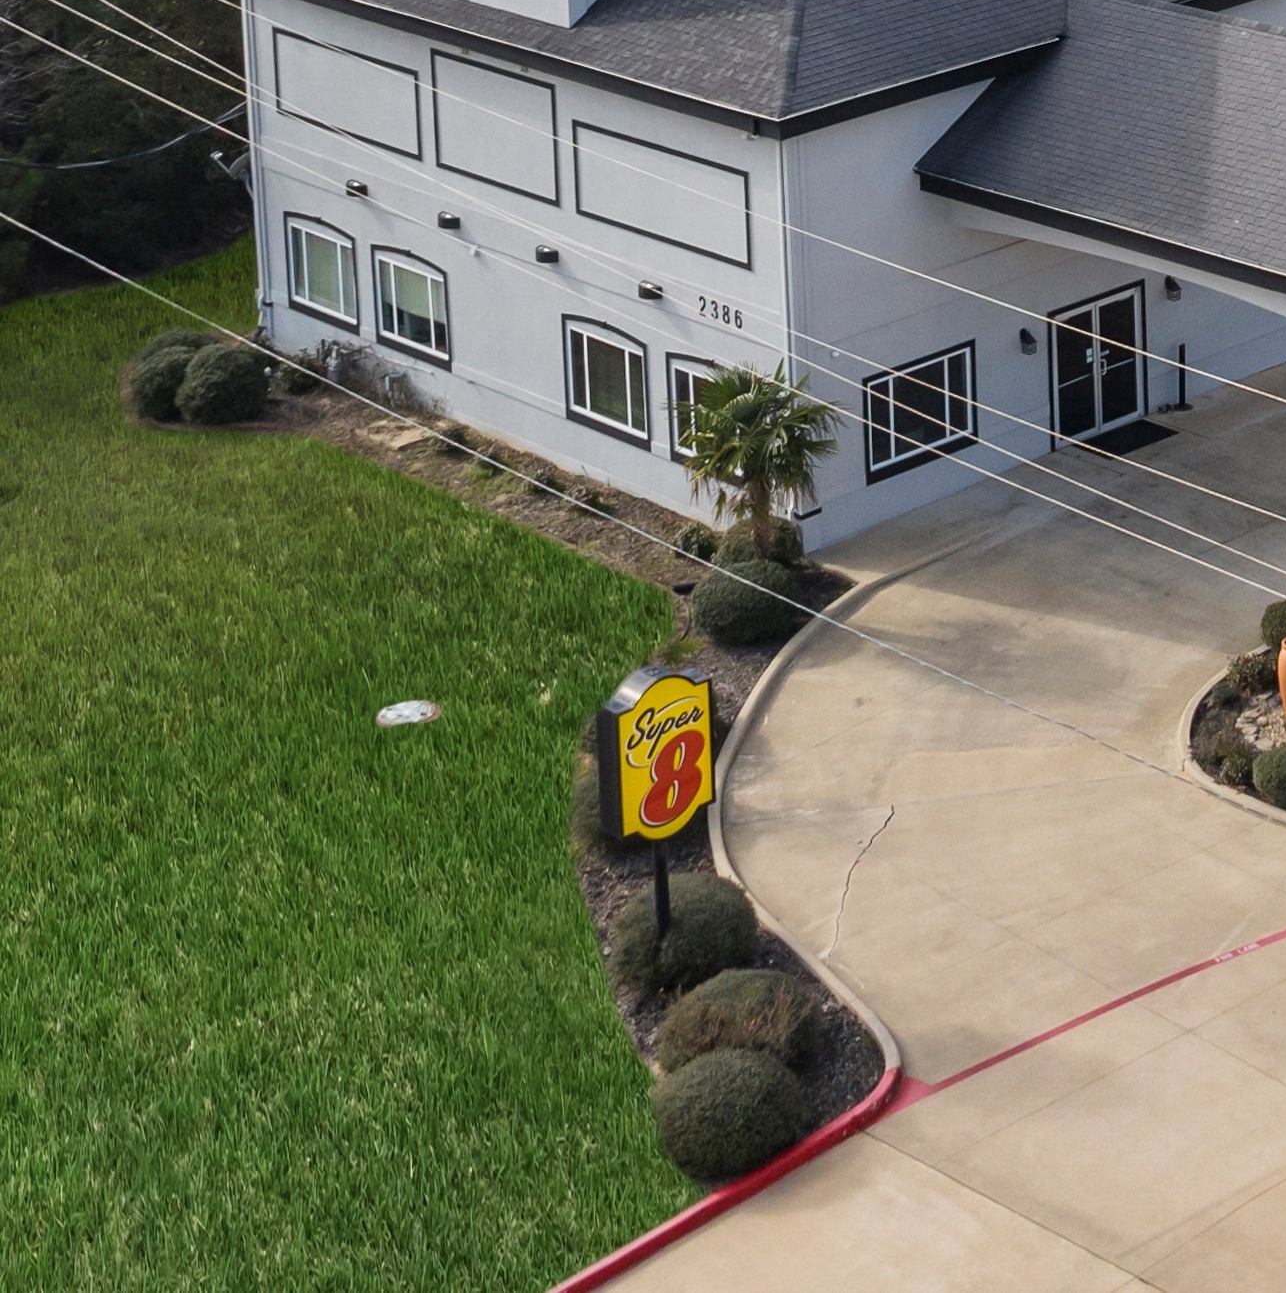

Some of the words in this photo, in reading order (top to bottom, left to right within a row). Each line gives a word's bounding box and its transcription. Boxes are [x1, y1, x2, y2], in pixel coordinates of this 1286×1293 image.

[699, 295, 743, 329] 2386
[625, 705, 704, 759] Super
[640, 729, 705, 827] 8
